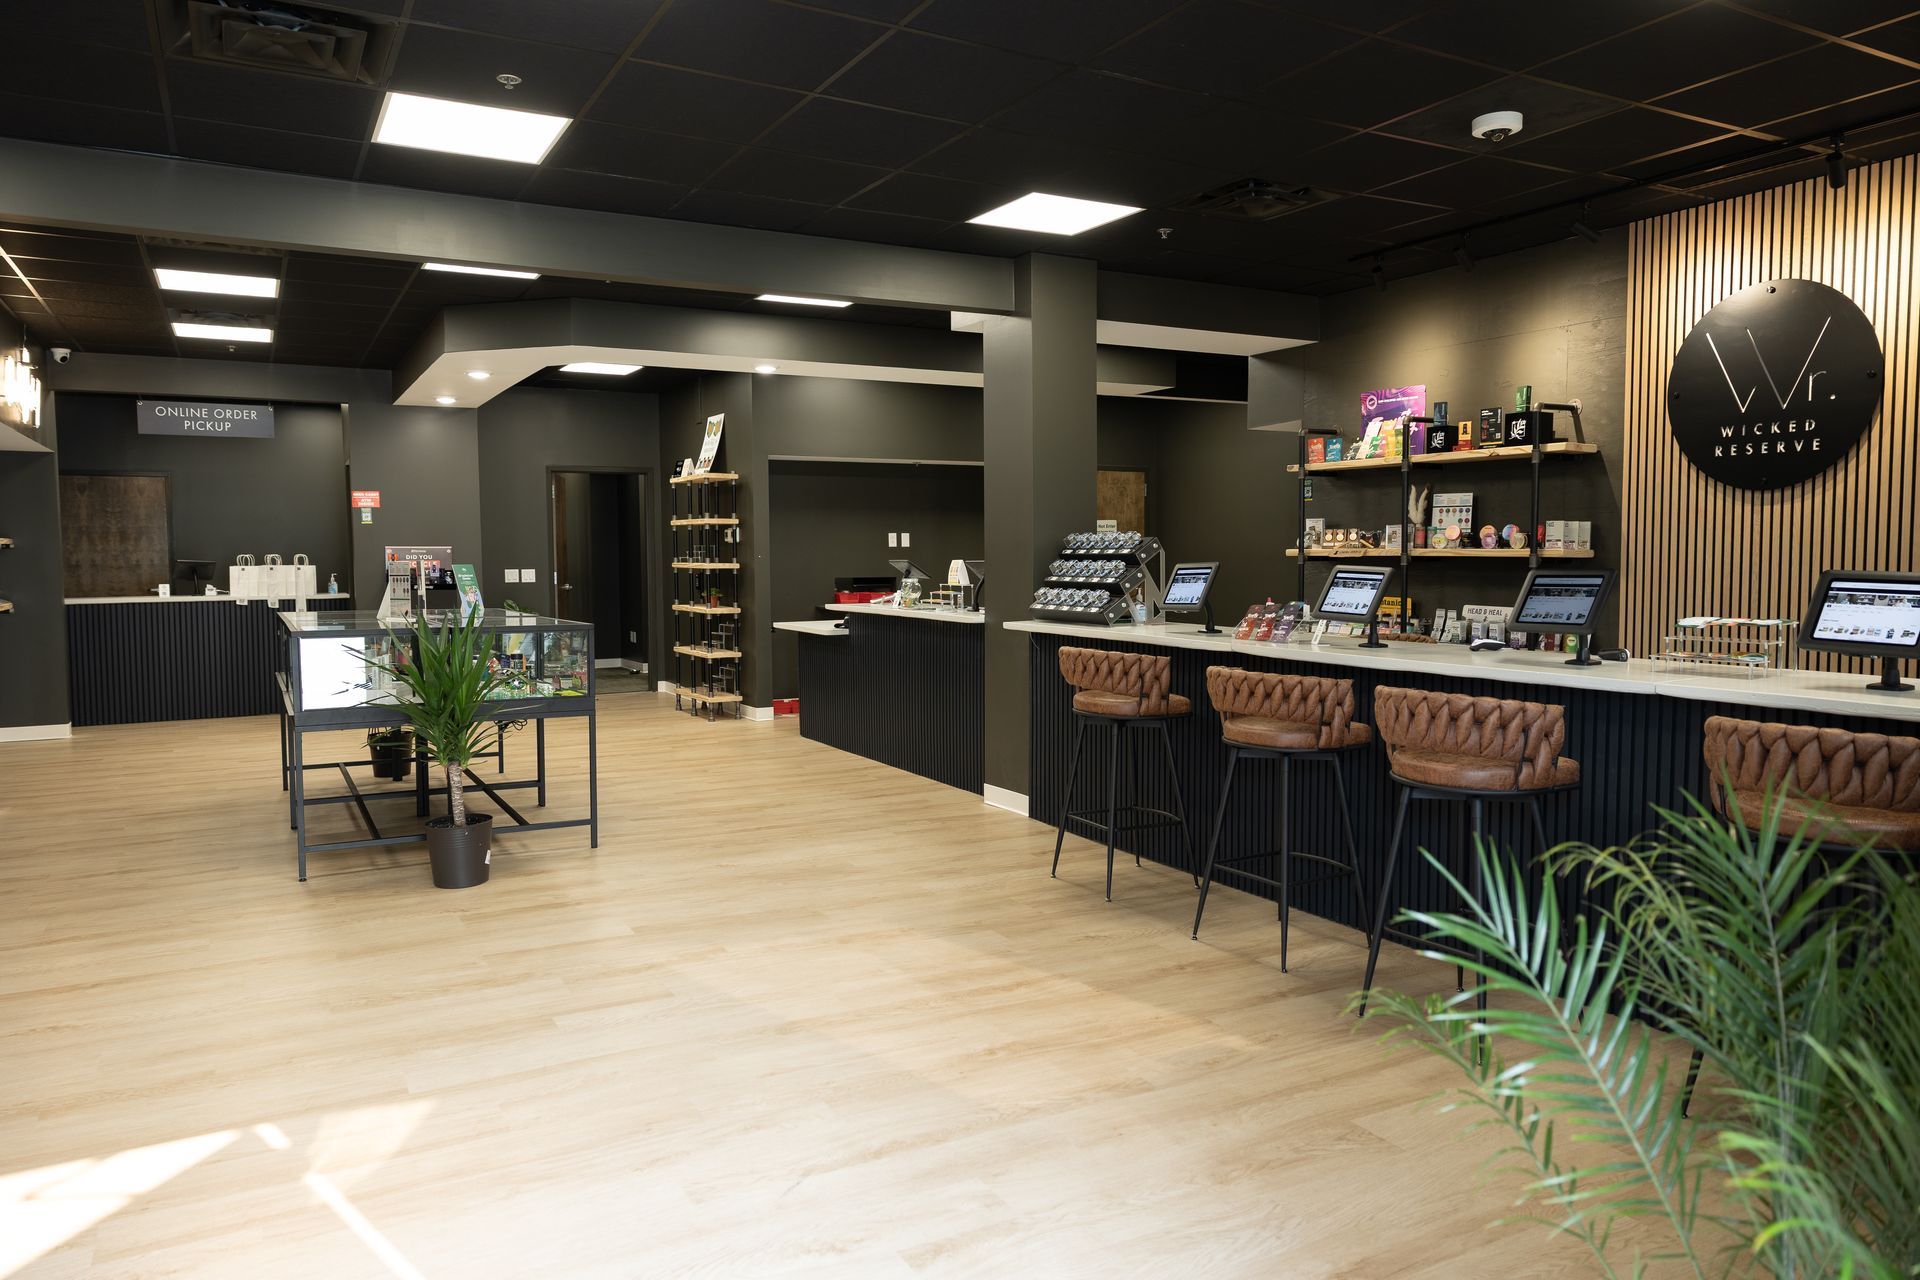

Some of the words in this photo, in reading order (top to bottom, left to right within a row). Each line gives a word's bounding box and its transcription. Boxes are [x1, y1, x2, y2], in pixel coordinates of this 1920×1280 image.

[155, 406, 209, 419] ONLINE
[213, 408, 258, 420] ORDER
[184, 420, 232, 432] PICKUP
[1720, 418, 1816, 438] WICKED
[1714, 438, 1821, 457] RESERVE
[1467, 607, 1482, 615] HEAD
